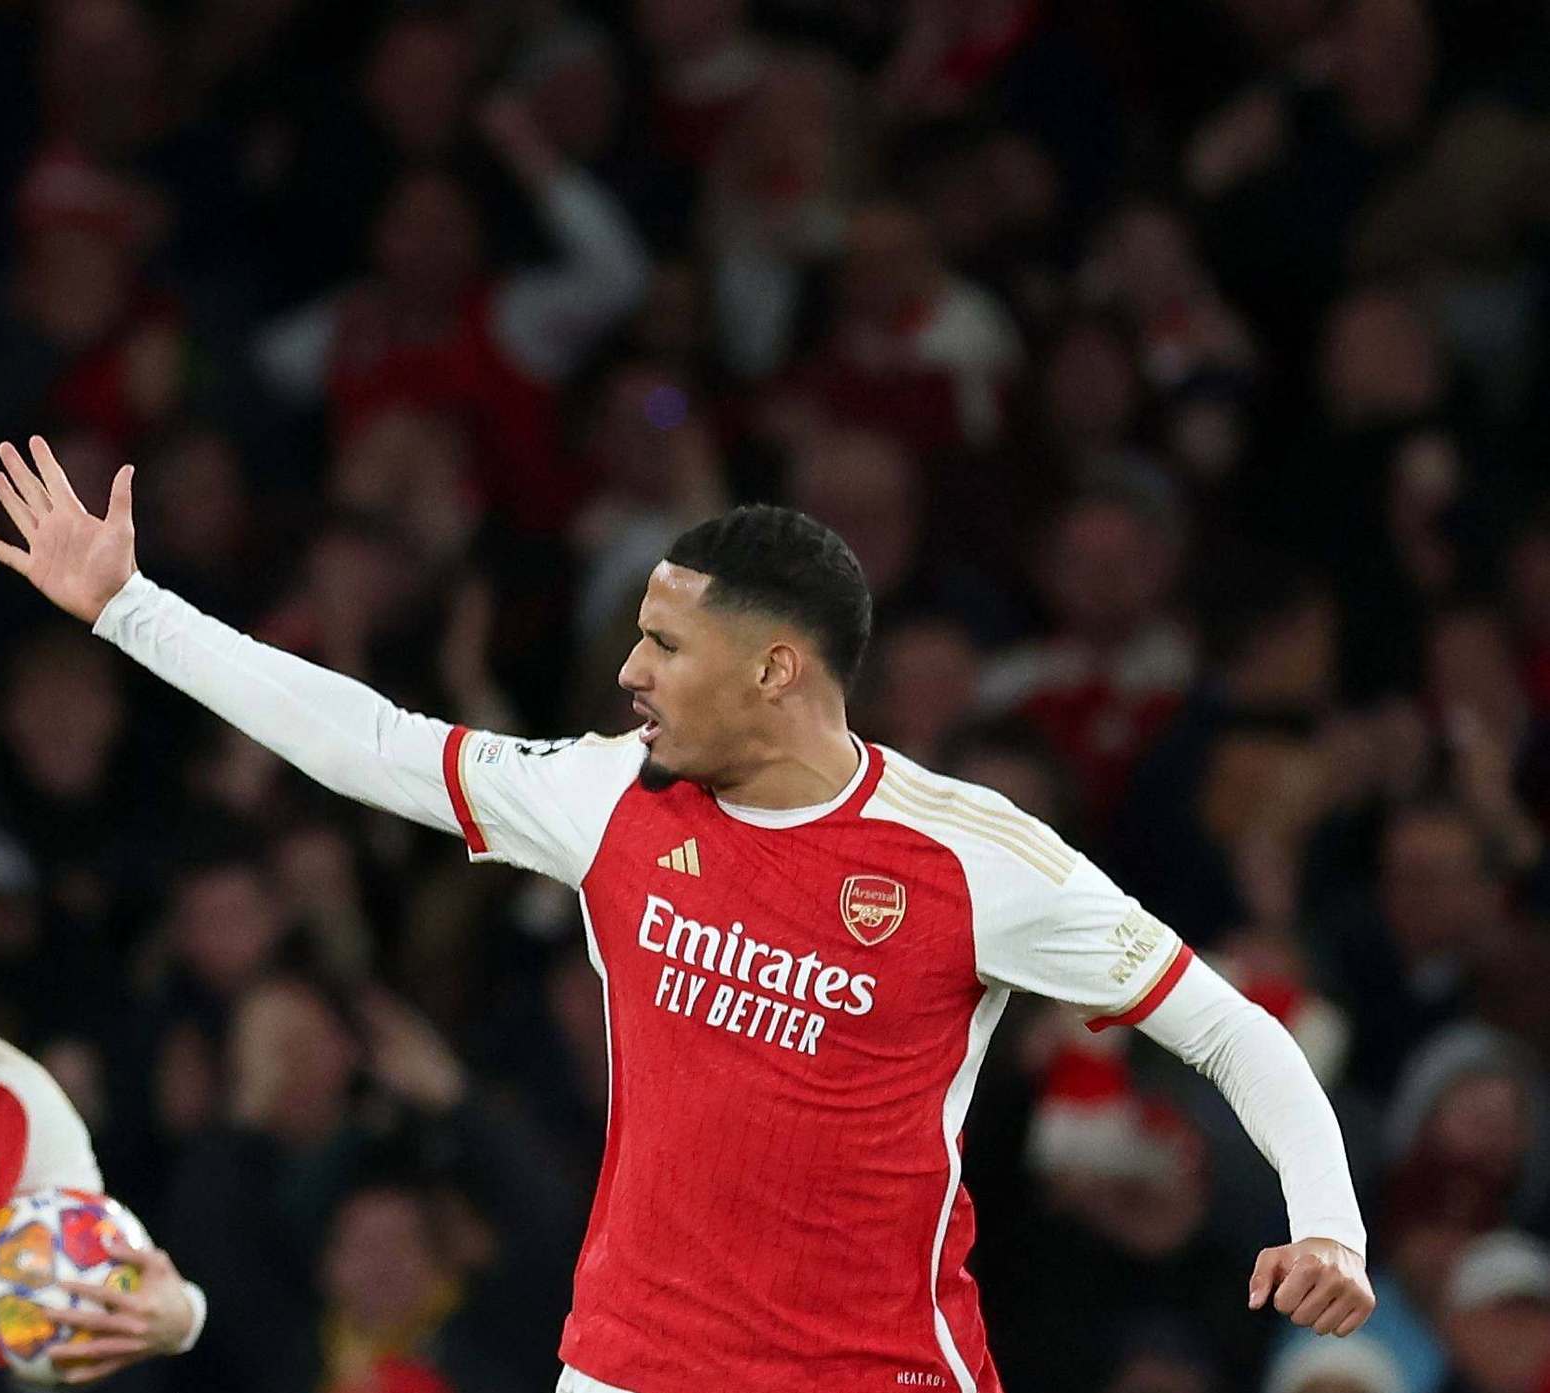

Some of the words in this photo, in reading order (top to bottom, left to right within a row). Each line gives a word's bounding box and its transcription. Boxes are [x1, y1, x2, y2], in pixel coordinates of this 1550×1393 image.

[638, 894, 877, 1016] Emirates
[654, 965, 707, 1018] FLY
[706, 983, 826, 1056] BETTER
